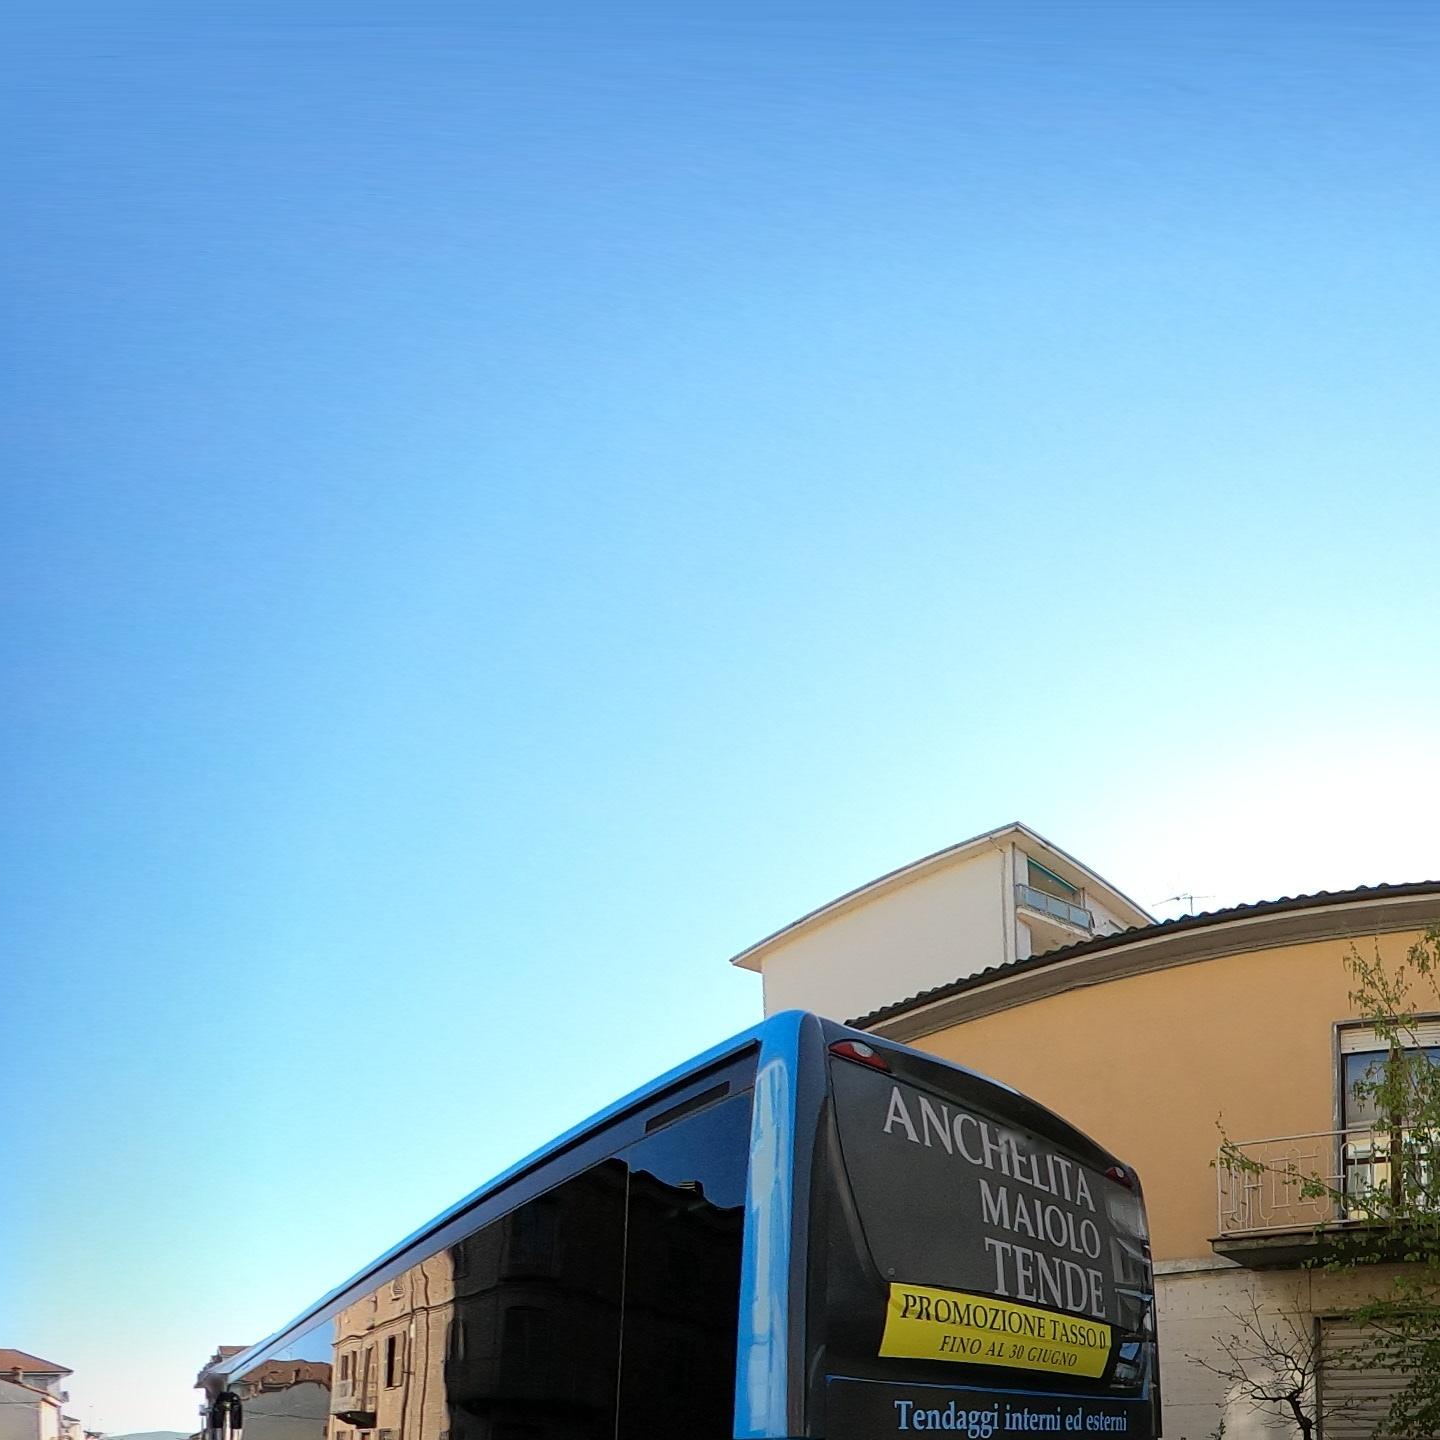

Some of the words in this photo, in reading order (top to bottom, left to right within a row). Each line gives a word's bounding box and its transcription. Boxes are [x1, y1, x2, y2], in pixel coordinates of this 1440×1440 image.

[882, 1086, 1097, 1213] ANCHELITA
[978, 1178, 1101, 1259] MAIOLO
[984, 1237, 1106, 1318] TENDE
[900, 1293, 1046, 1338] PROMOZIONE
[1050, 1319, 1097, 1348] TASSO
[939, 1335, 982, 1354] FINO
[983, 1341, 1005, 1358] AL
[1009, 1344, 1025, 1359] 30
[1027, 1346, 1078, 1367] GIUGNO
[894, 1400, 999, 1439] Tendaggi
[1004, 1404, 1061, 1431] interni
[1065, 1407, 1083, 1431] ed
[1086, 1410, 1128, 1432] esterni
